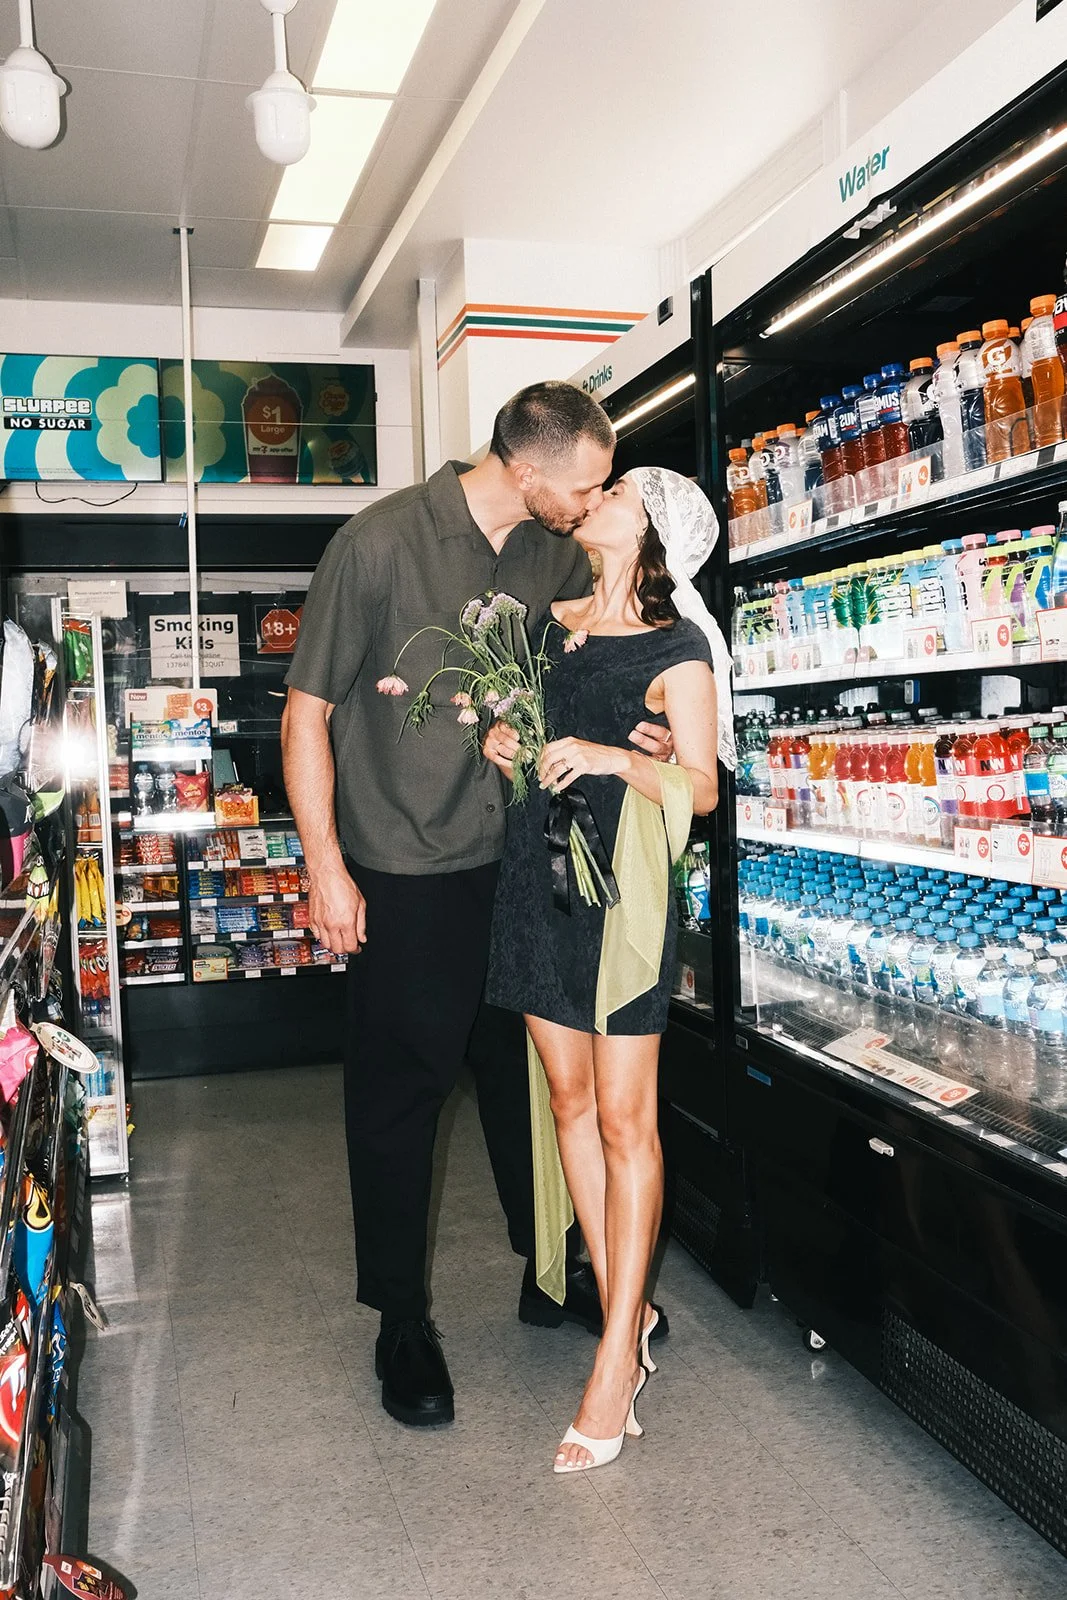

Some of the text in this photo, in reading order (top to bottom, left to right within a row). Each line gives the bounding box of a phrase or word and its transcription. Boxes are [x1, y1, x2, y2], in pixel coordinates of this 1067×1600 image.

[839, 145, 890, 203] Water
[589, 365, 612, 394] Drinks
[262, 404, 281, 425] $1
[10, 418, 86, 429] NO SUGAR
[260, 425, 285, 435] Large
[263, 620, 297, 636] 18+
[130, 693, 146, 701] New
[174, 730, 207, 738] mentos
